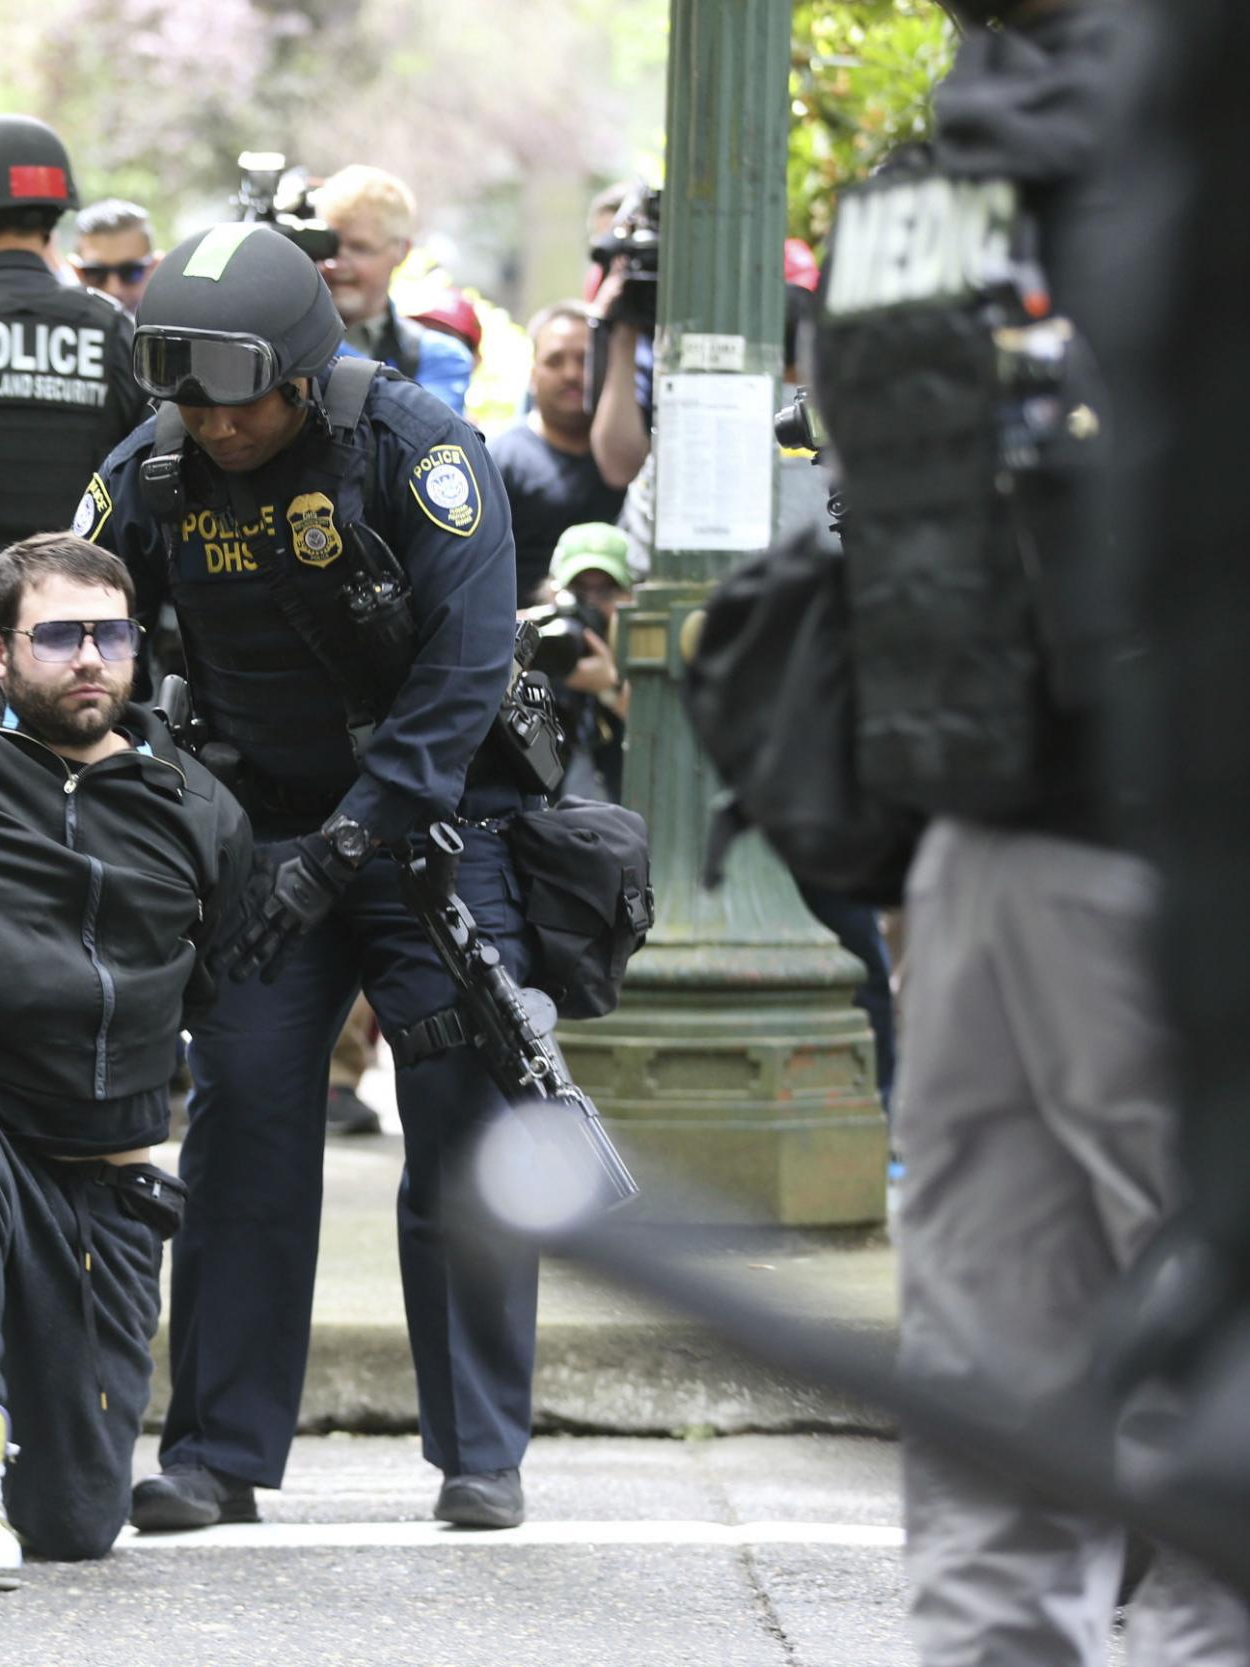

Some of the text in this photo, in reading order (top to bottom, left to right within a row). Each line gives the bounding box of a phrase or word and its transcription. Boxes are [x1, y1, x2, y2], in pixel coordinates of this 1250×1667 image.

[34, 375, 108, 408] SECURITY
[413, 450, 461, 480] POLICE
[204, 541, 259, 574] DHS
